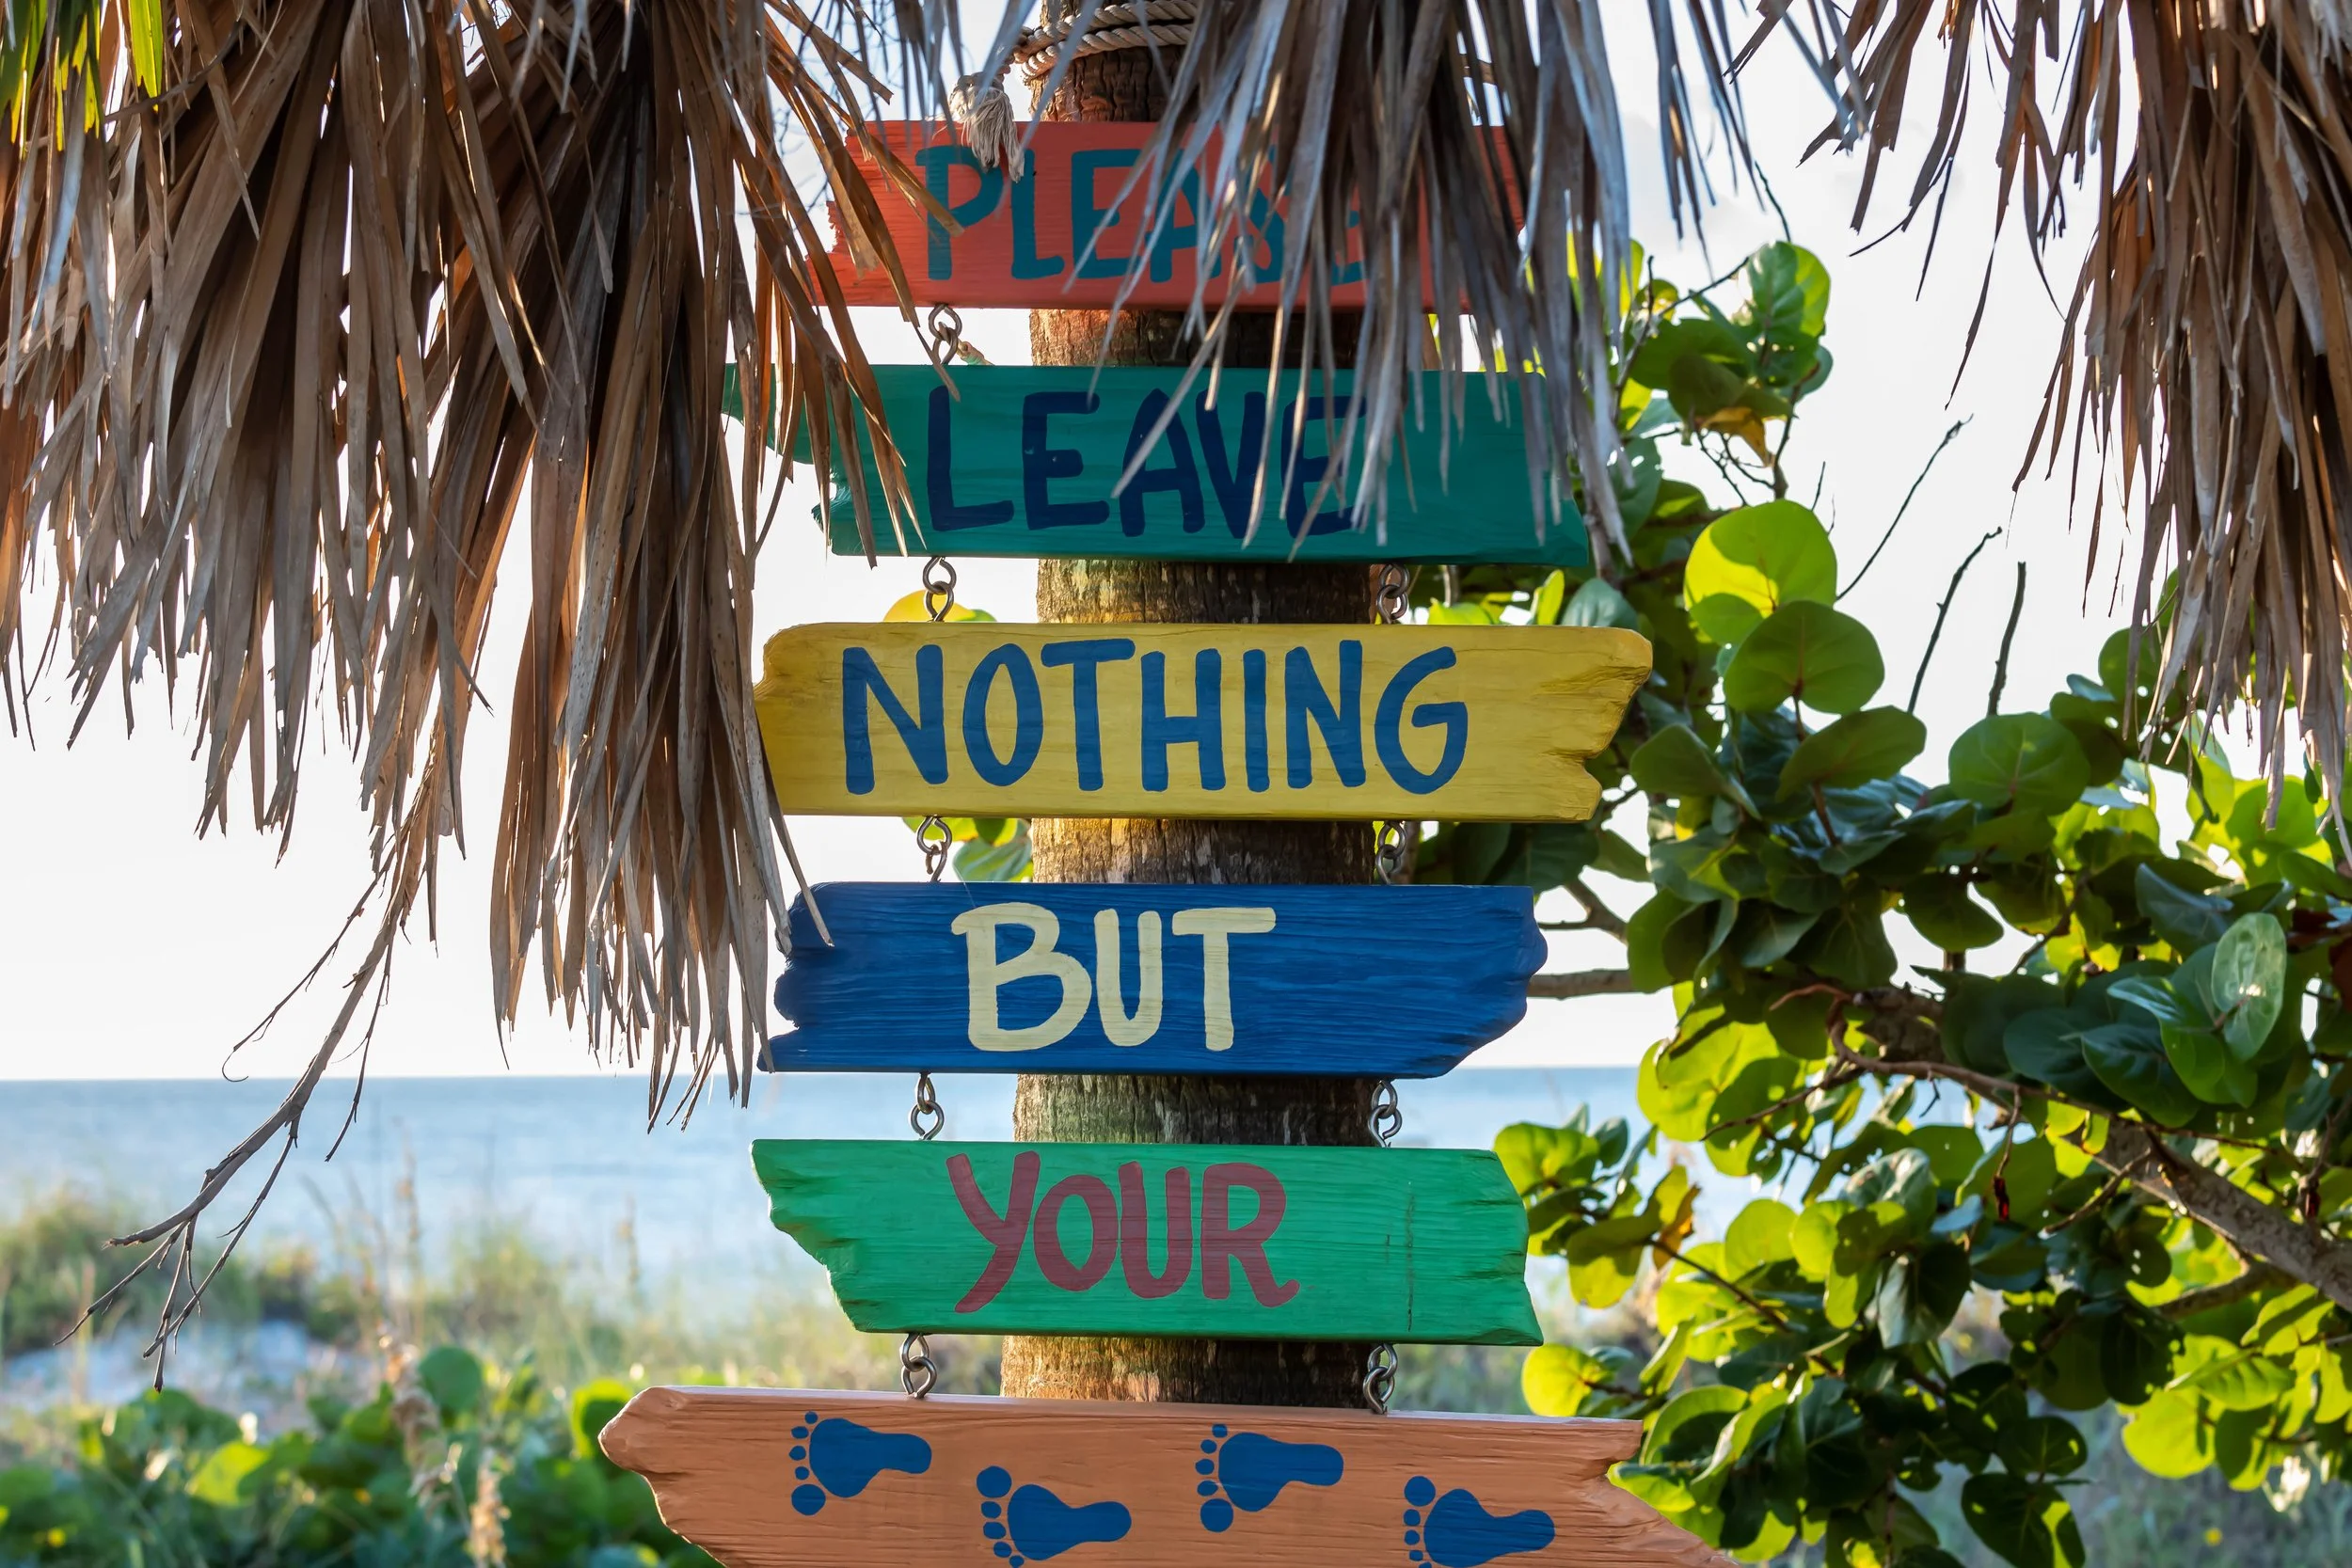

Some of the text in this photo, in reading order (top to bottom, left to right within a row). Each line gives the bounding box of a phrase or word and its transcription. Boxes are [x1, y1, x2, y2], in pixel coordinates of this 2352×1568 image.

[915, 146, 1368, 286] PLEAS
[927, 388, 1368, 537] LEAVE
[842, 640, 1469, 795] NOTHING
[951, 902, 1277, 1052] BUT
[946, 1150, 1301, 1313] YOUR
